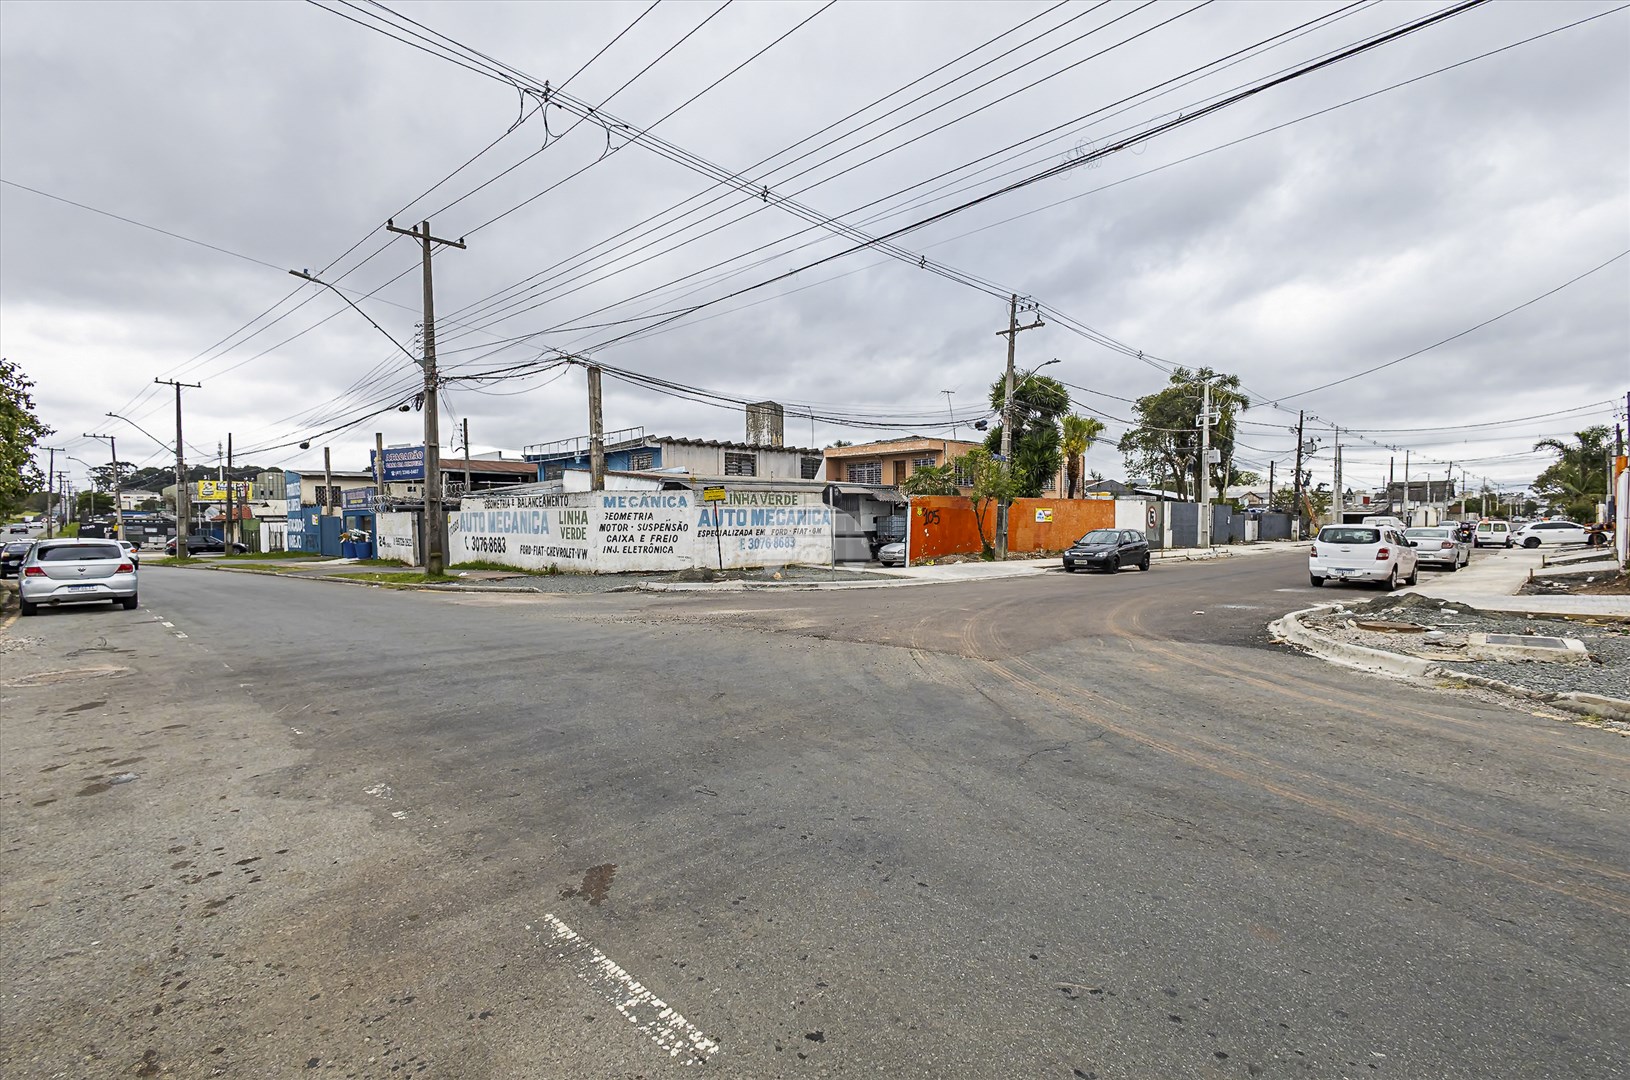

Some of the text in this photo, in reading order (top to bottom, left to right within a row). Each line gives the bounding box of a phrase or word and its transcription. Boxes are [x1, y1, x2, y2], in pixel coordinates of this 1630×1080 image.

[517, 495, 569, 508] BALANCEAMENTO
[603, 492, 688, 508] MECÂNICA
[761, 493, 798, 506] VERDE
[460, 511, 485, 533] AUTO
[487, 511, 550, 535] MECANICA
[558, 510, 589, 525] LINHA
[697, 508, 747, 528] AUTO
[922, 507, 940, 526] 105
[599, 520, 689, 532] MOTOR SUSPENSÃO
[697, 528, 753, 538] ESPECIALIZADA
[771, 528, 788, 536] FORD
[792, 527, 808, 535] FIAT
[560, 527, 587, 540] VERDE
[606, 534, 679, 543] CAIXA E FREIO
[603, 543, 674, 554] INJ. ELETRÔNICA
